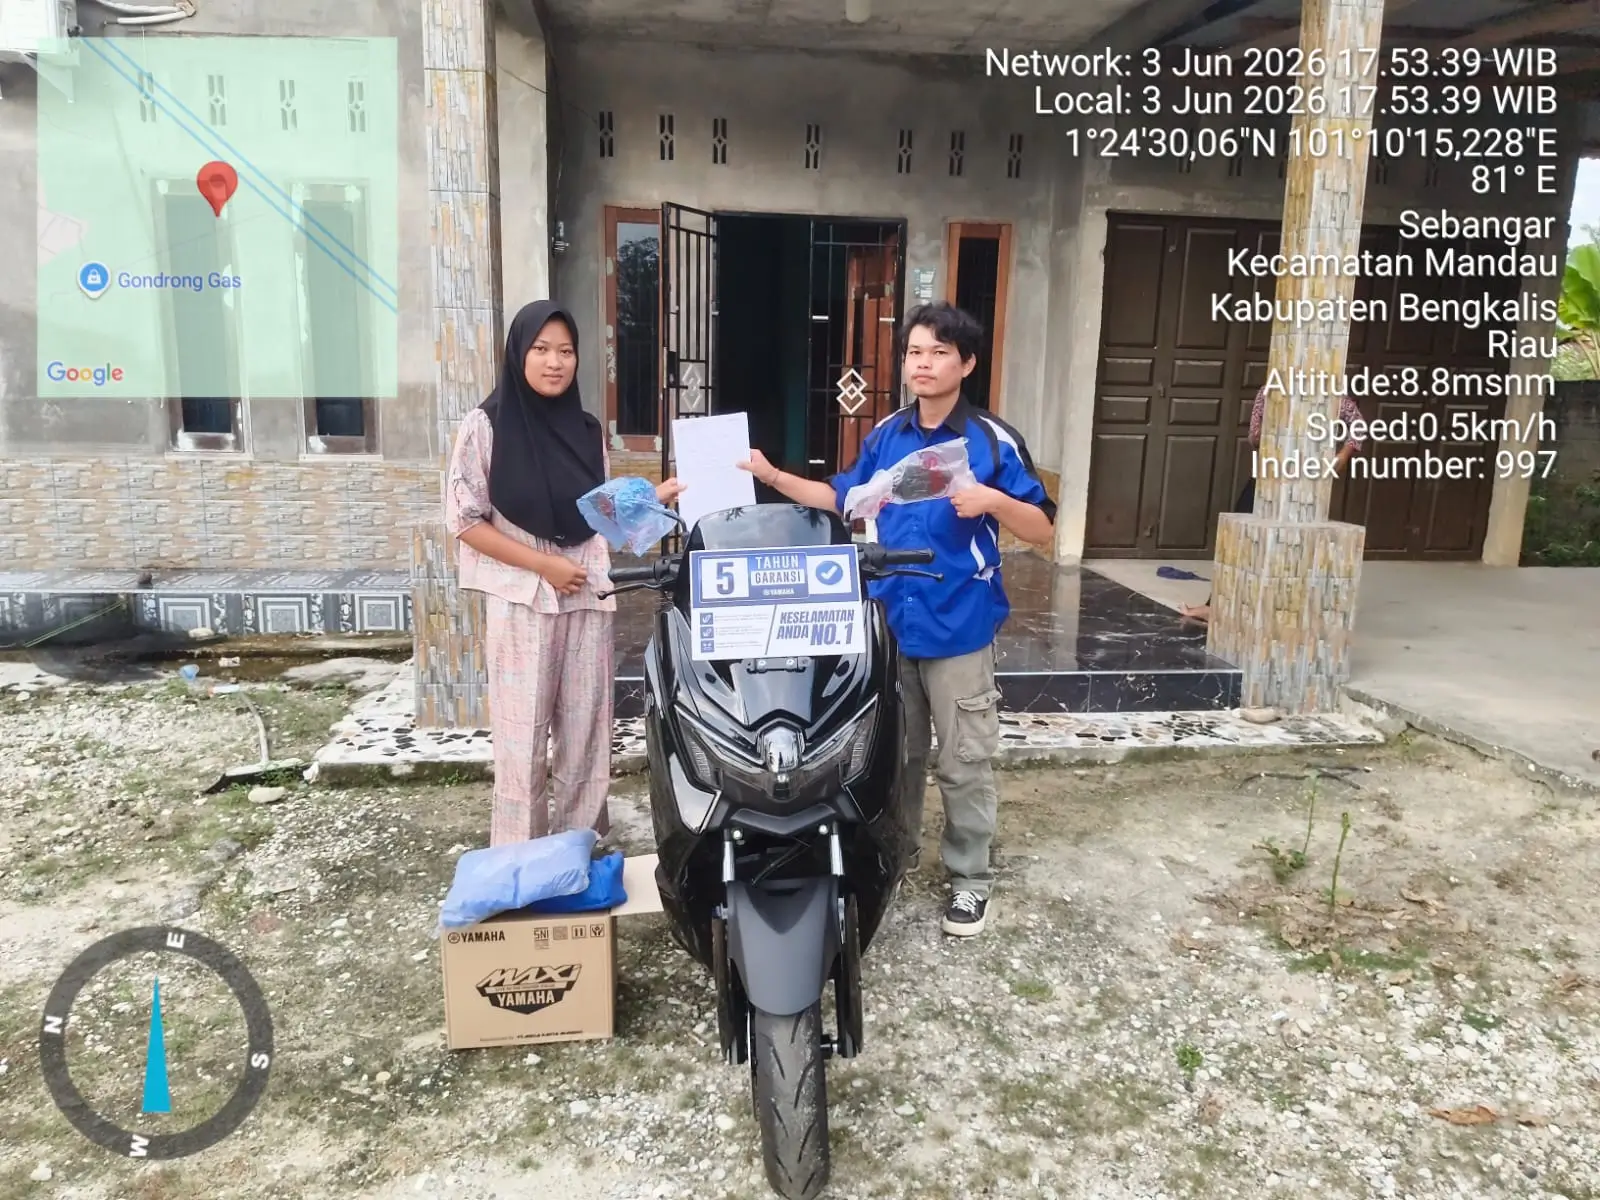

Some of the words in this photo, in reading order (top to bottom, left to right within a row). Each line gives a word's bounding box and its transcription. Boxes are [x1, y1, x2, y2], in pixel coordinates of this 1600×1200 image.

[755, 555, 799, 569] TAHUN
[716, 561, 735, 595] 5
[755, 570, 801, 584] GARANSI
[780, 609, 855, 624] KESELAMATAN
[776, 625, 809, 640] ANDA
[461, 930, 506, 943] YAMAHA
[496, 990, 555, 1007] YAMAHA
